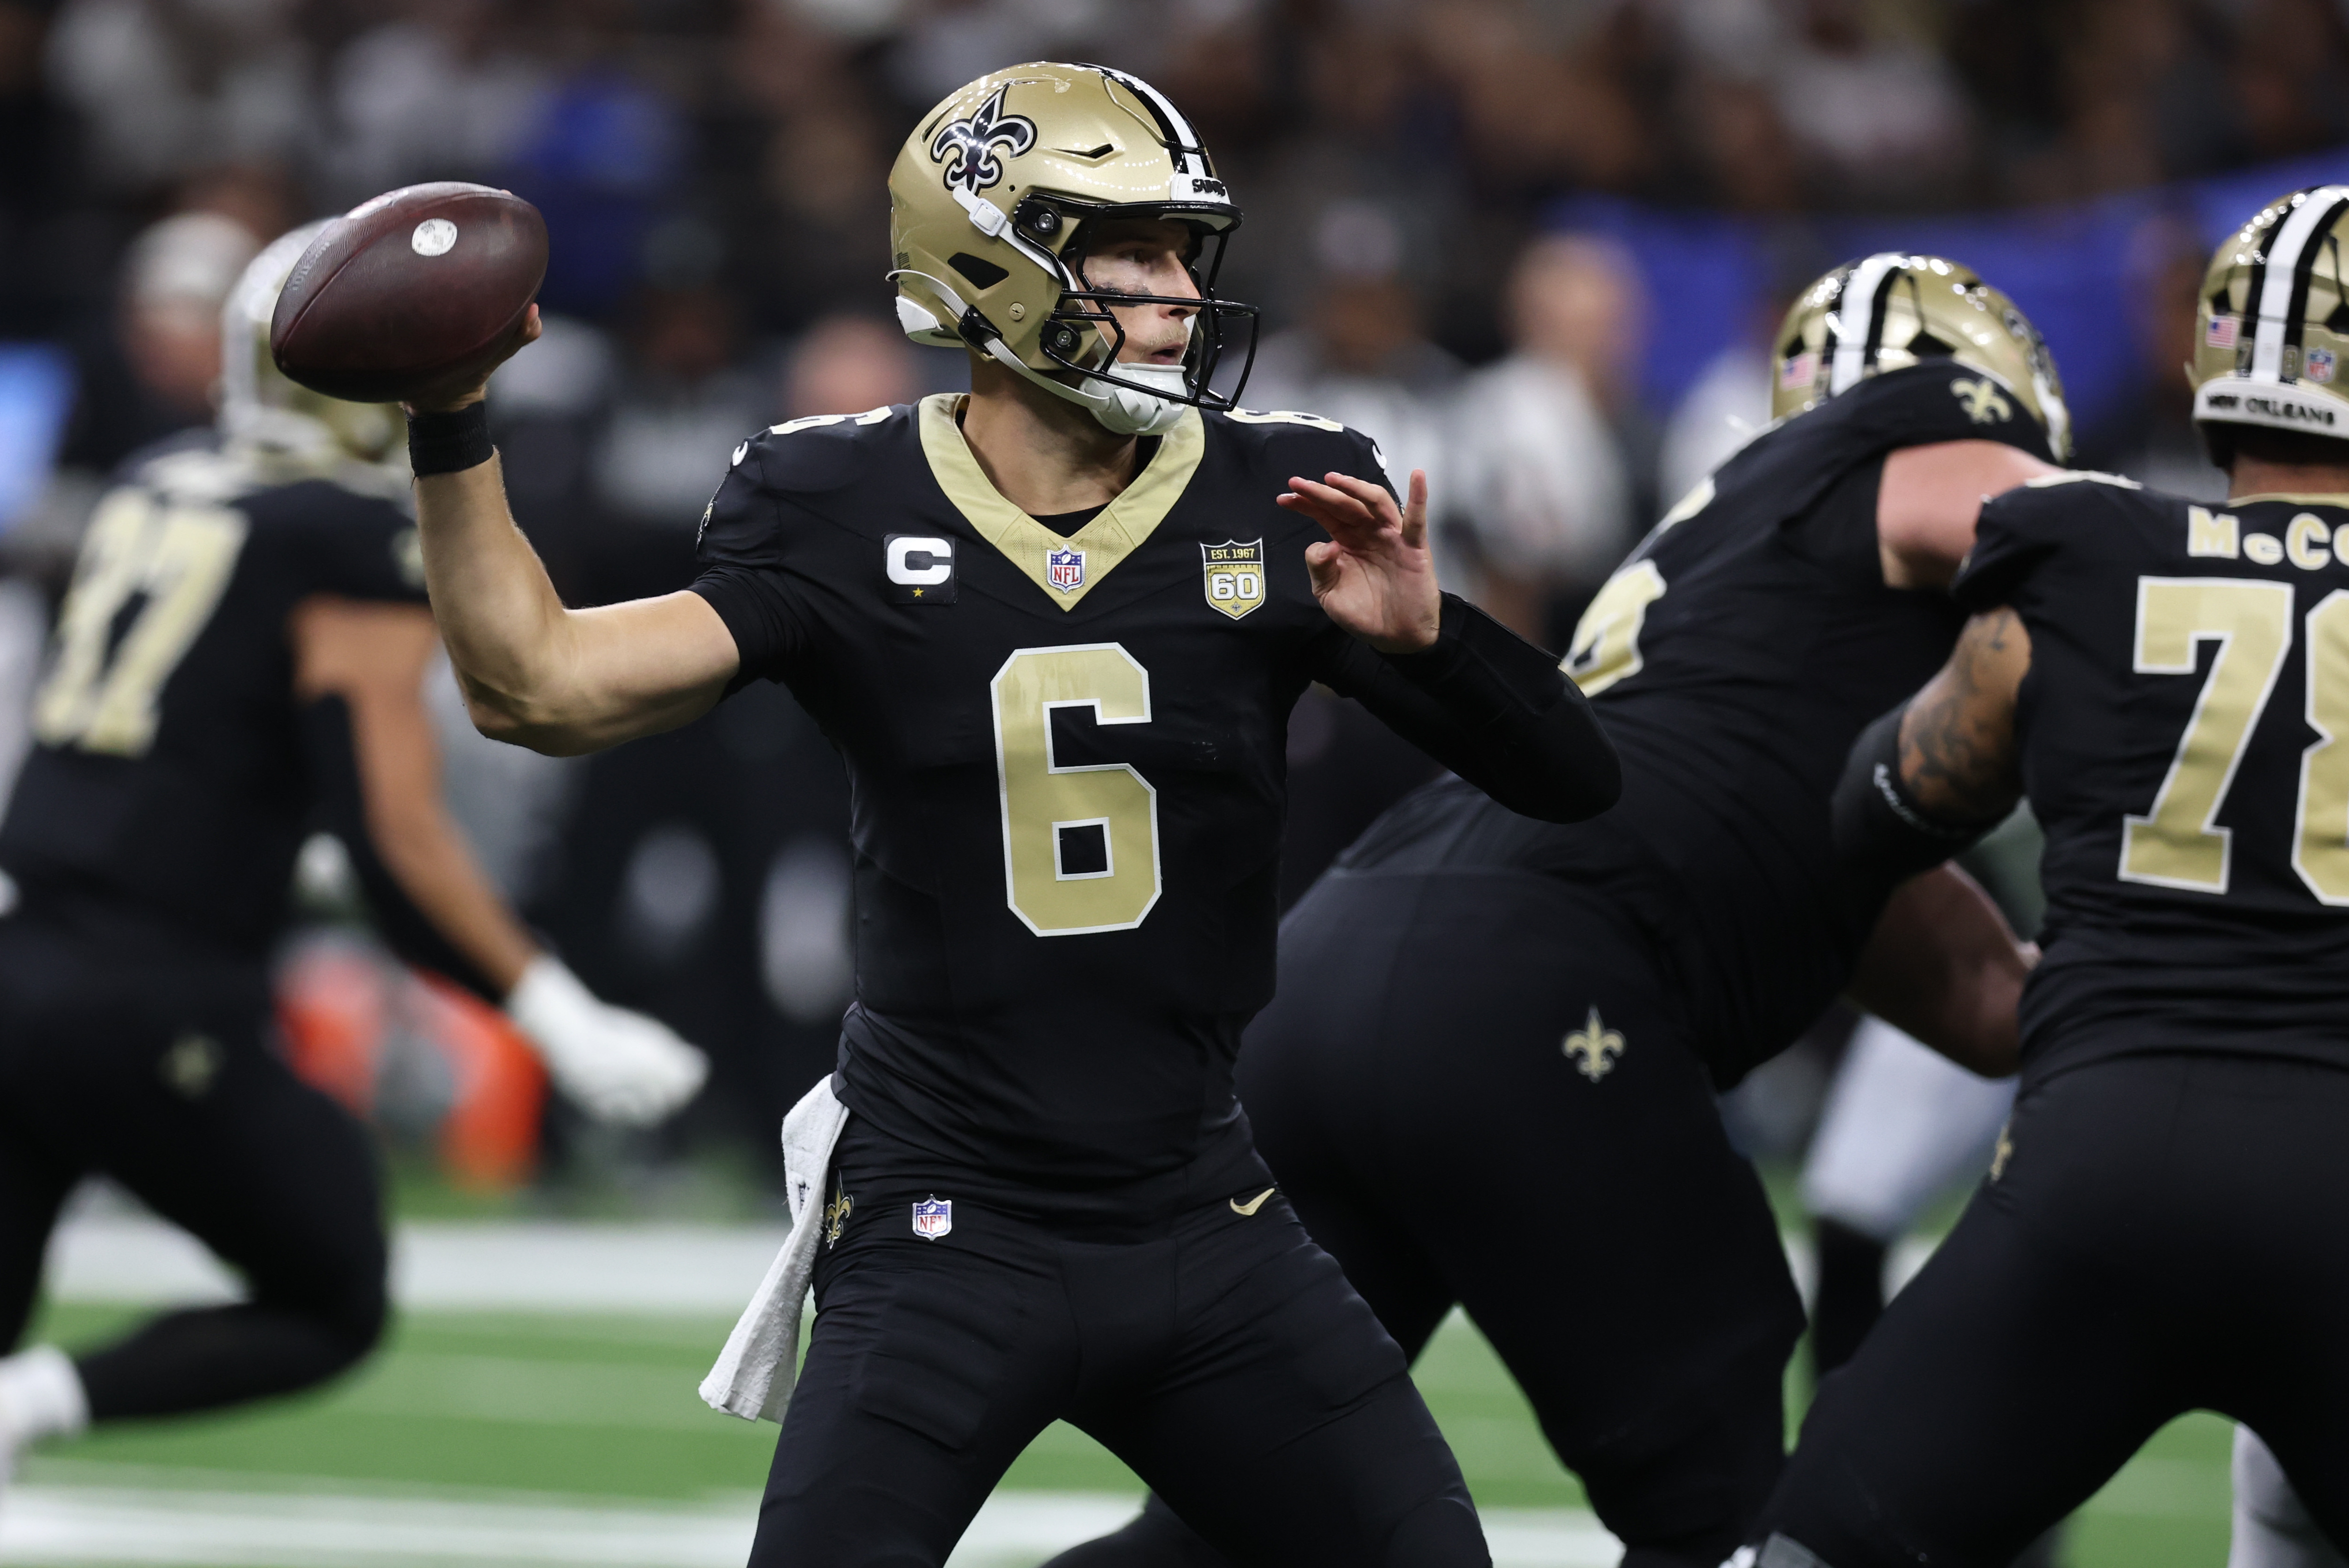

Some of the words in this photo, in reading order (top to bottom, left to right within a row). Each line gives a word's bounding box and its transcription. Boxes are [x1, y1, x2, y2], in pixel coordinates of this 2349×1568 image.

[887, 537, 952, 585] C
[1211, 549, 1230, 560] EST.
[1231, 548, 1255, 559] 1967
[1053, 566, 1079, 585] NFL
[1210, 572, 1260, 601] 60
[990, 642, 1162, 938] 6
